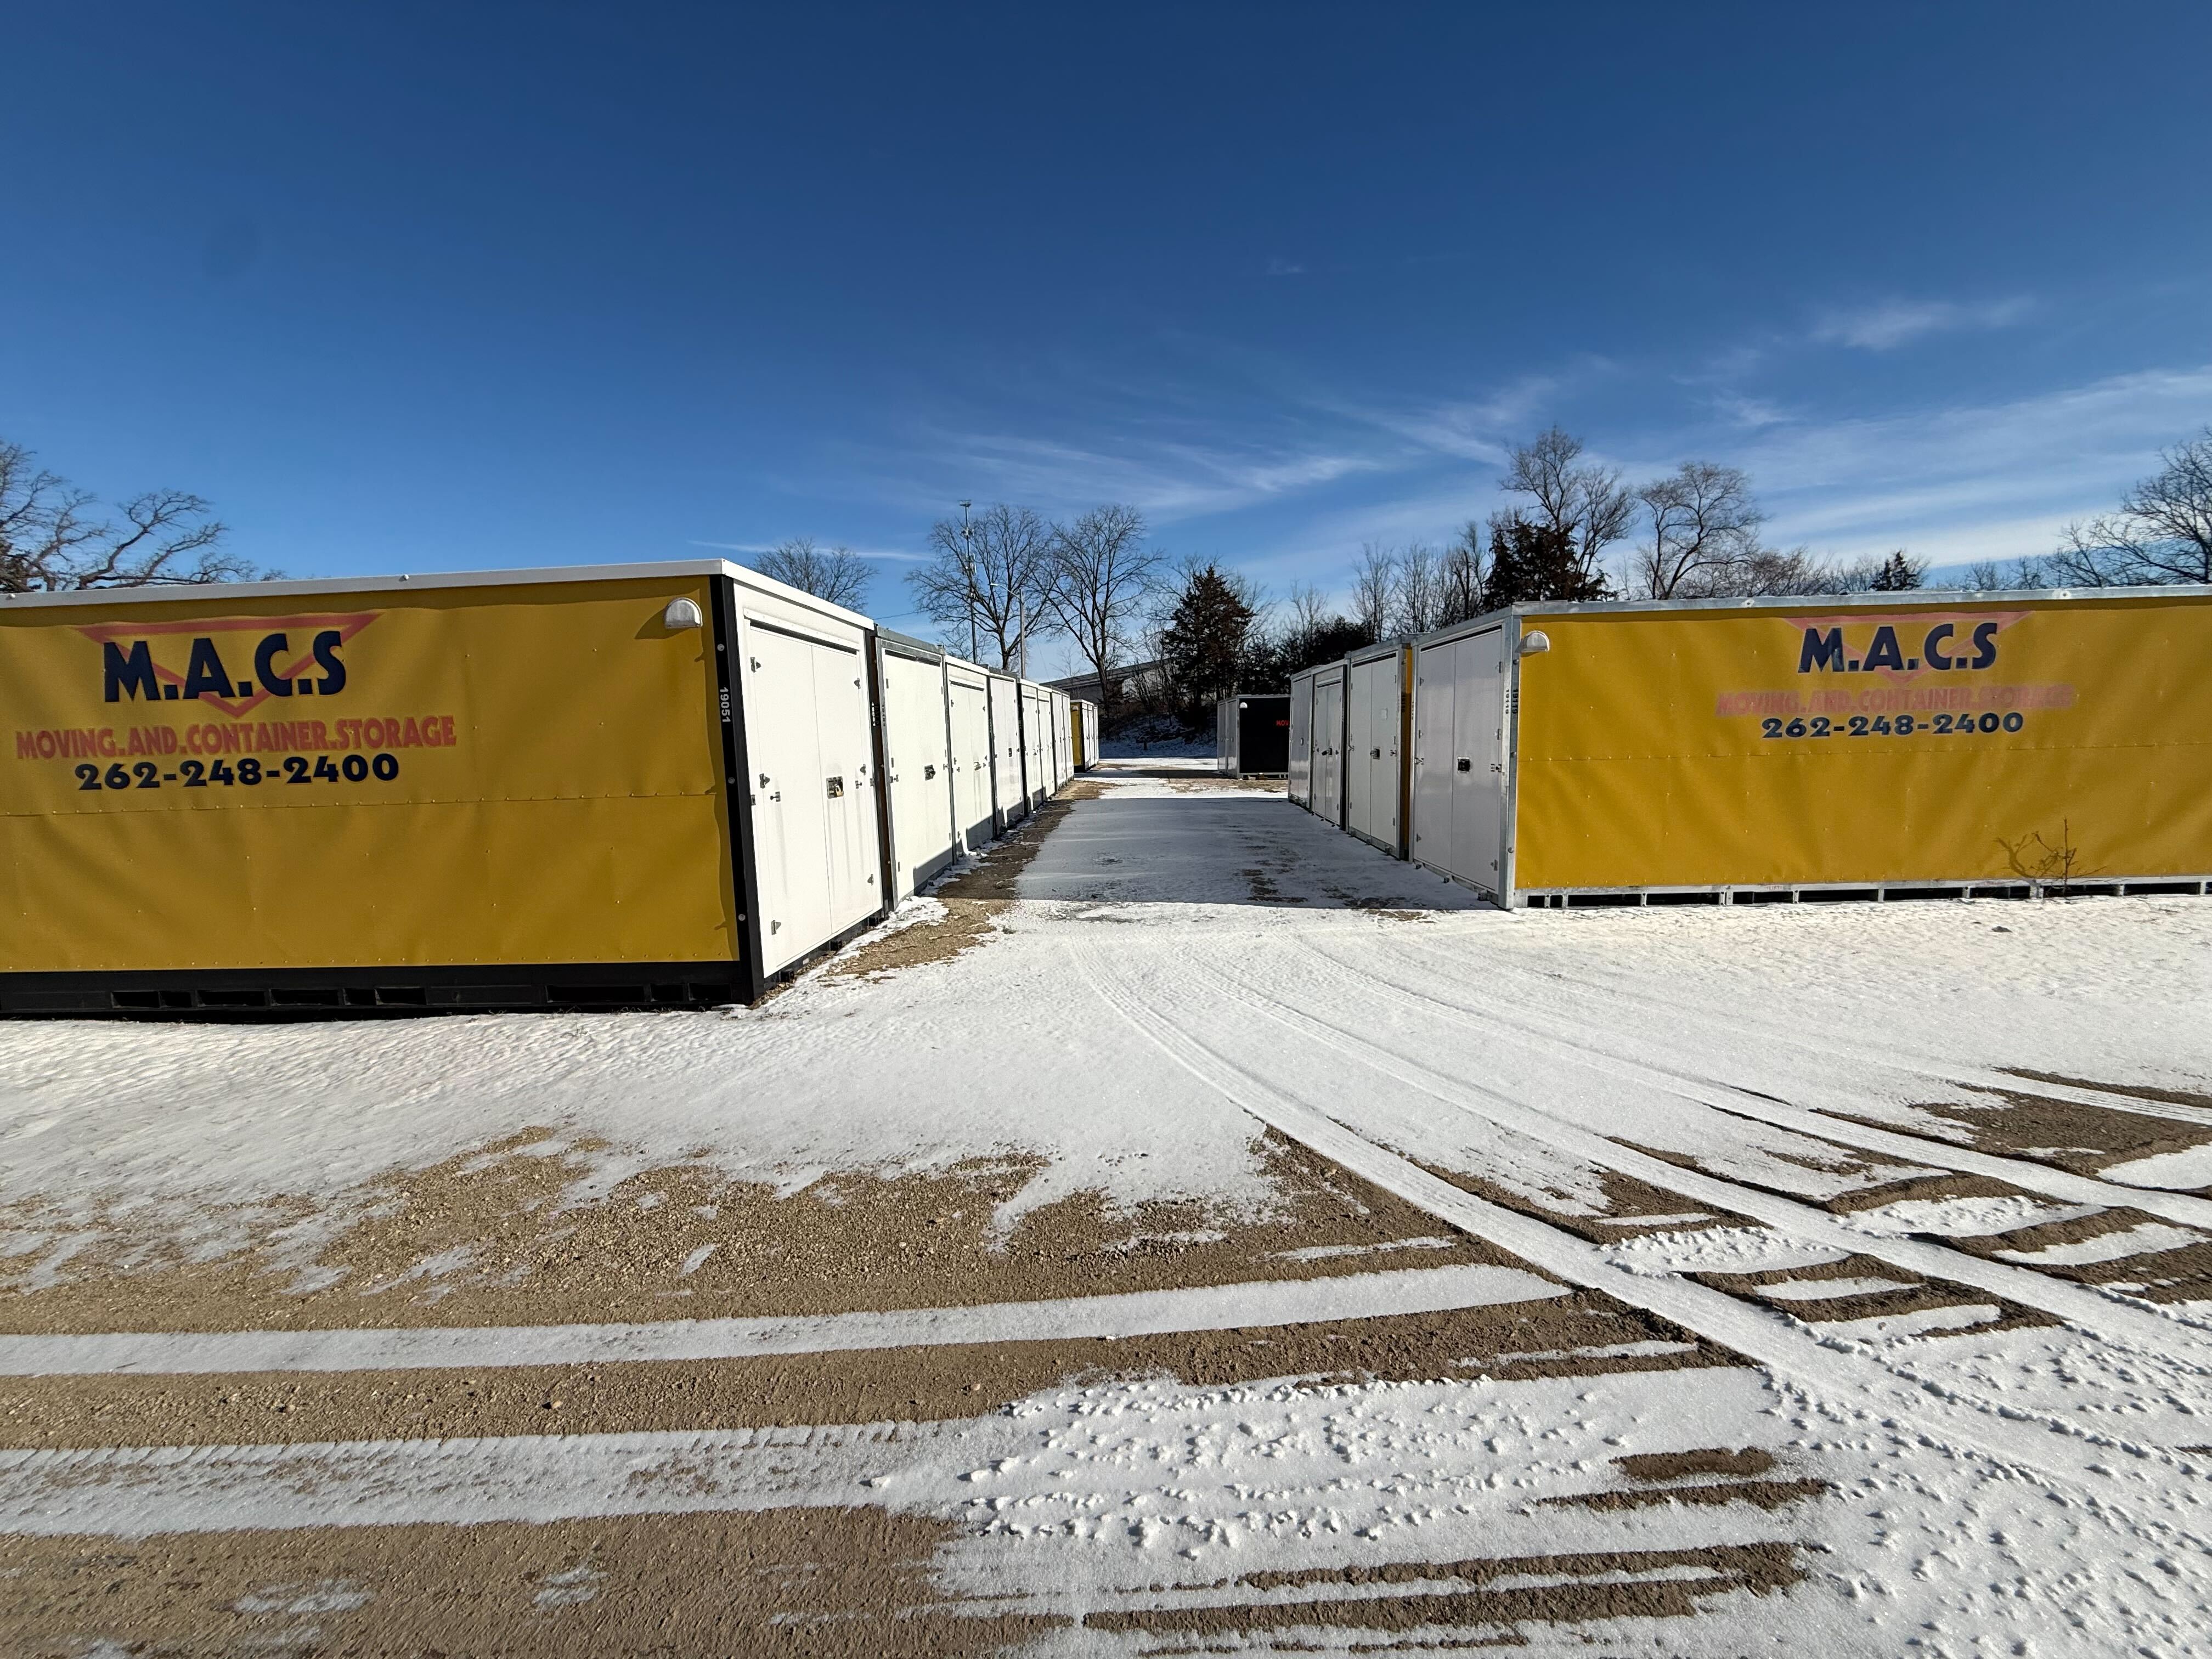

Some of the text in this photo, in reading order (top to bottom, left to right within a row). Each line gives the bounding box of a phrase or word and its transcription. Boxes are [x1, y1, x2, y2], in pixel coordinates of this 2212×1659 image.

[1798, 622, 1998, 673] M.A.C.S
[104, 631, 347, 703] M.A.C.S
[719, 687, 731, 723] 19051
[1762, 712, 2023, 738] 262-248-2400
[75, 753, 399, 791] 262-248-2400
